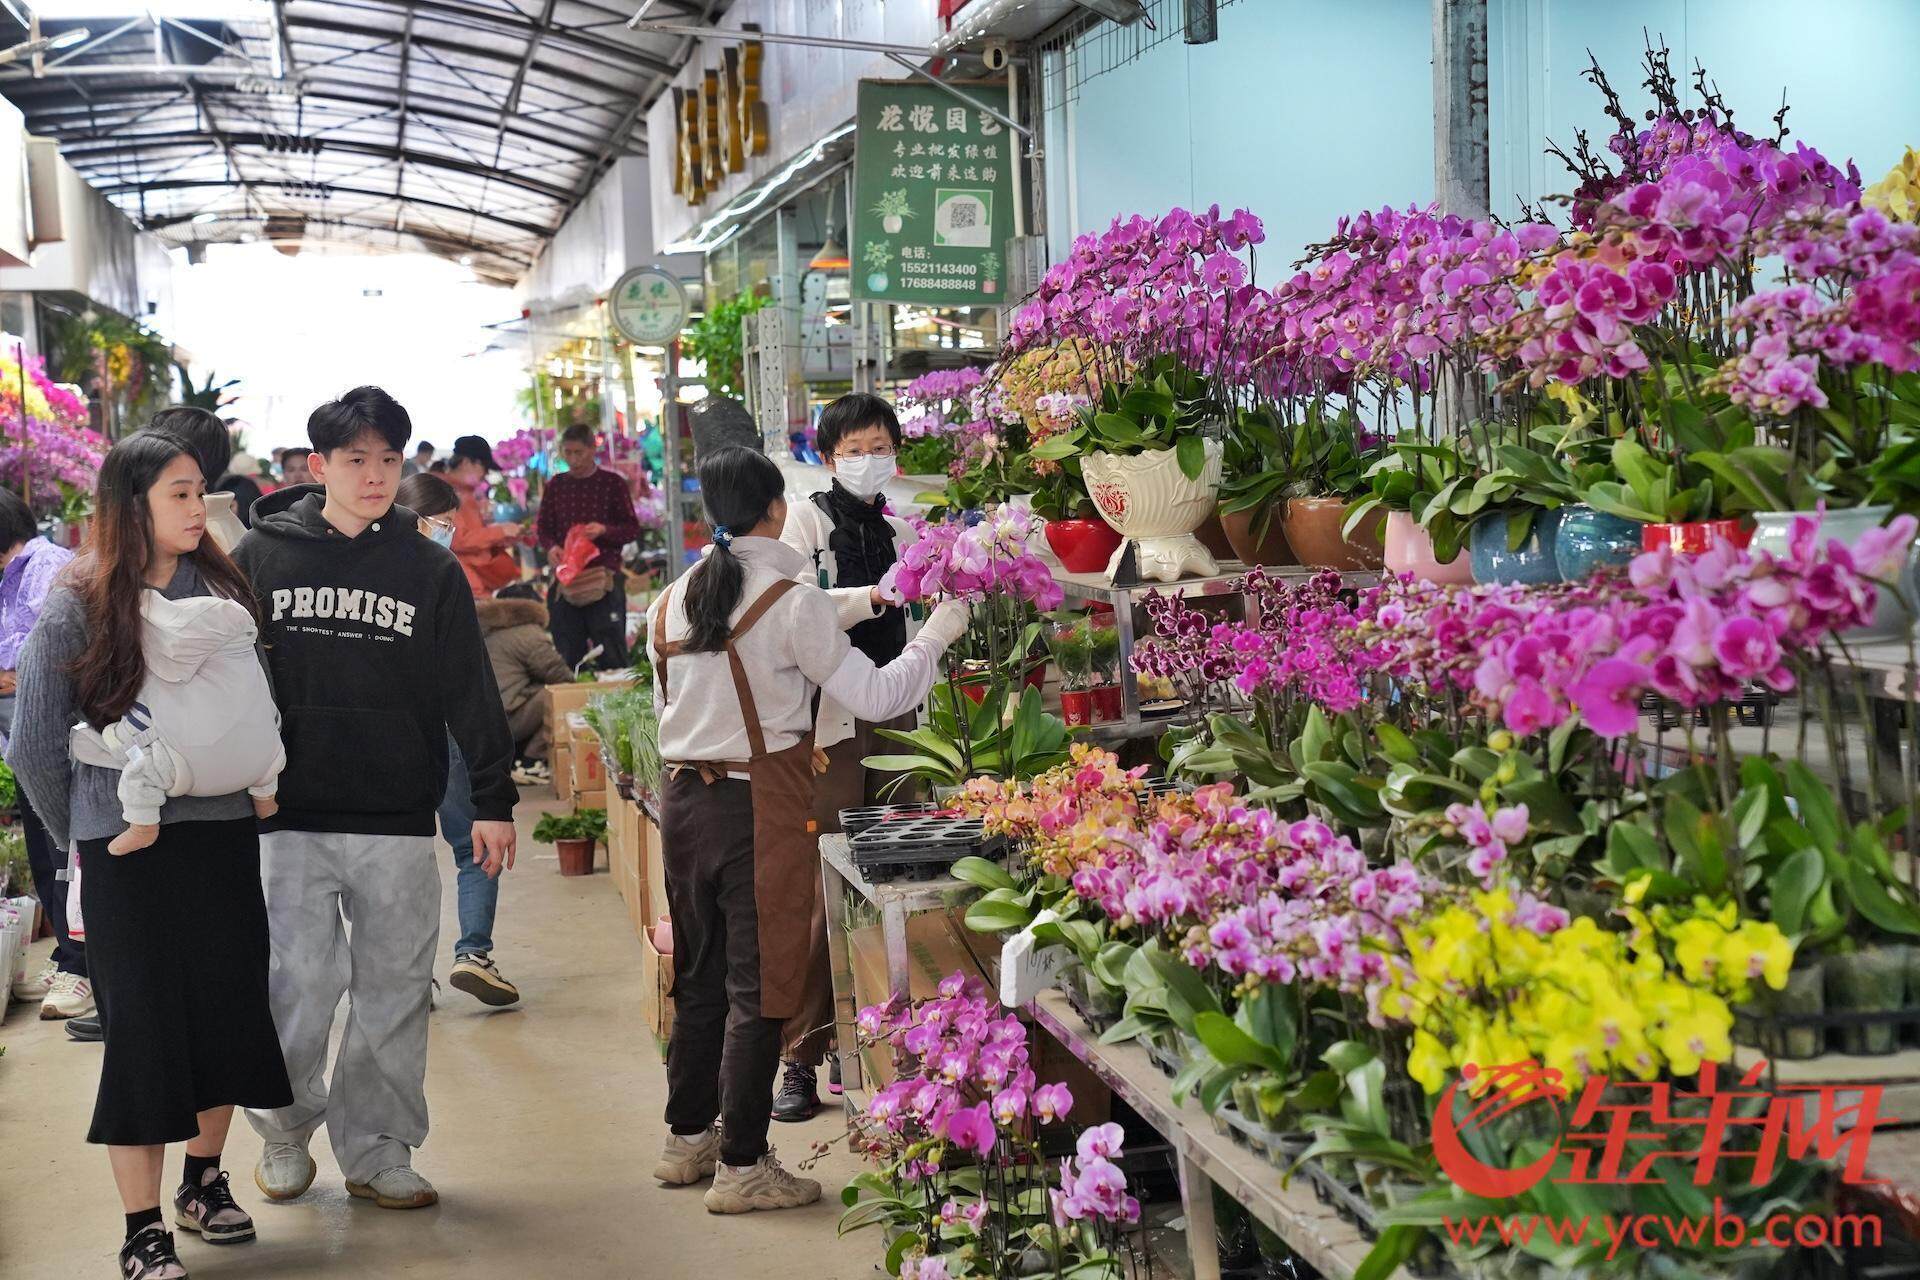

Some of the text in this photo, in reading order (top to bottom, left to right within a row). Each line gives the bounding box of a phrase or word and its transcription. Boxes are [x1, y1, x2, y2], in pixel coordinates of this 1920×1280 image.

[876, 104, 1003, 137] 花悦园艺
[892, 140, 999, 160] 专业批发绿植
[890, 163, 998, 184] 欢迎前来选购
[900, 262, 977, 275] 15521143400
[899, 277, 977, 290] 17688488848
[271, 586, 416, 637] PROMISE
[302, 626, 334, 636] SHORTEST
[337, 631, 363, 639] ANSWER
